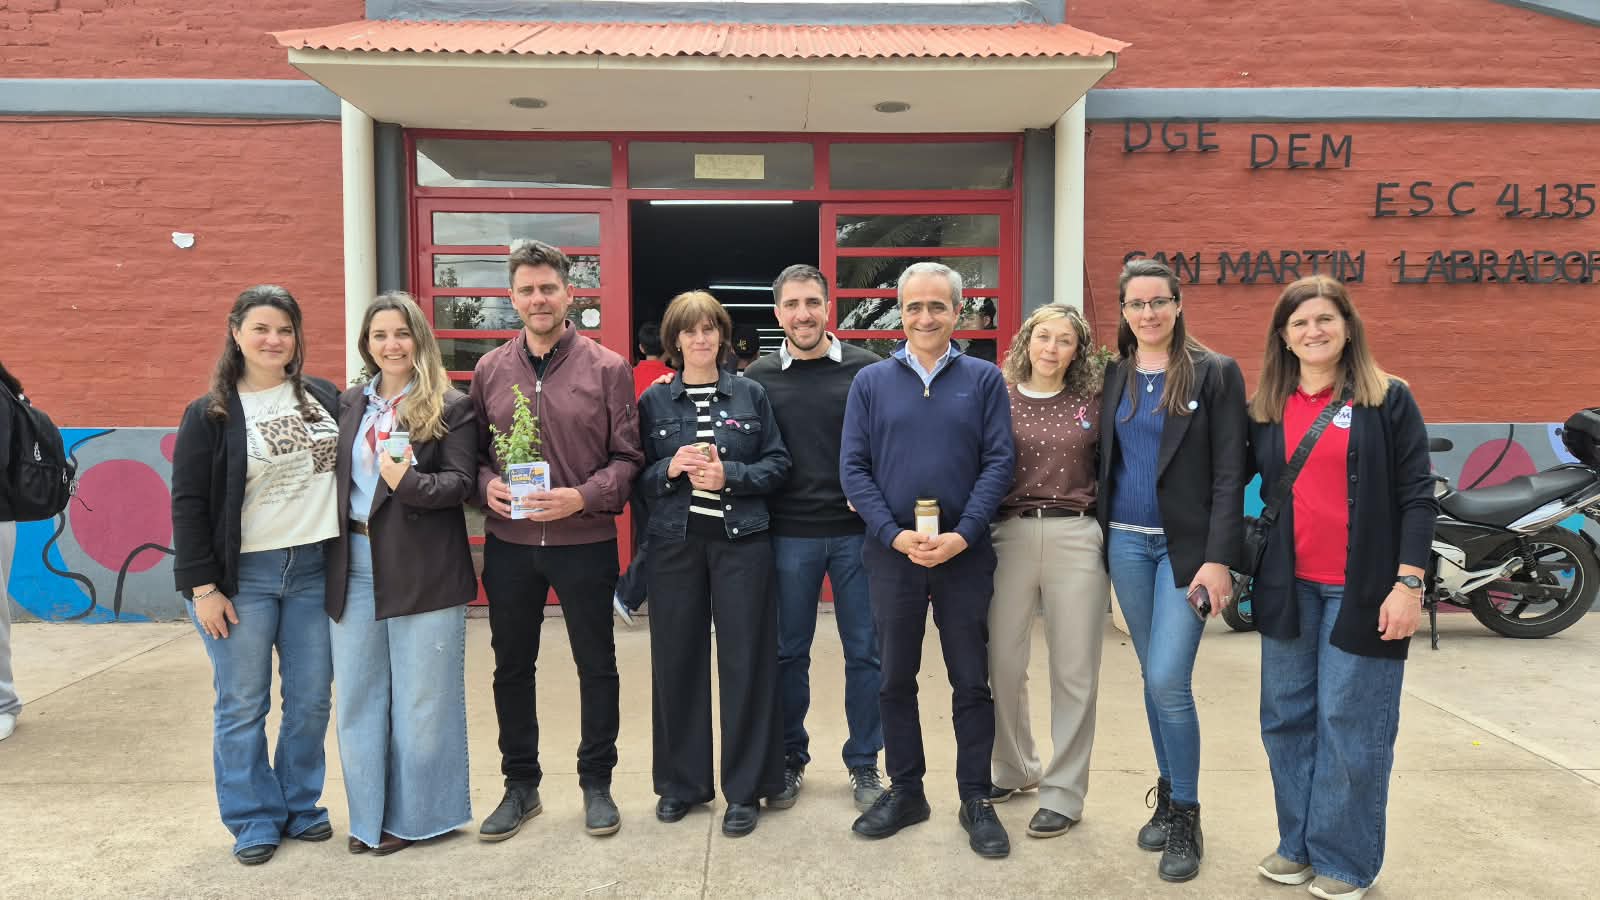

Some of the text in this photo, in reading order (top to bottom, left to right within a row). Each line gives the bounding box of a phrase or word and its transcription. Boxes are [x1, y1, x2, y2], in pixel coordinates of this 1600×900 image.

[1123, 117, 1353, 169] DGE DEM
[1375, 181, 1476, 217] ESC
[1216, 249, 1366, 285] MARTIN
